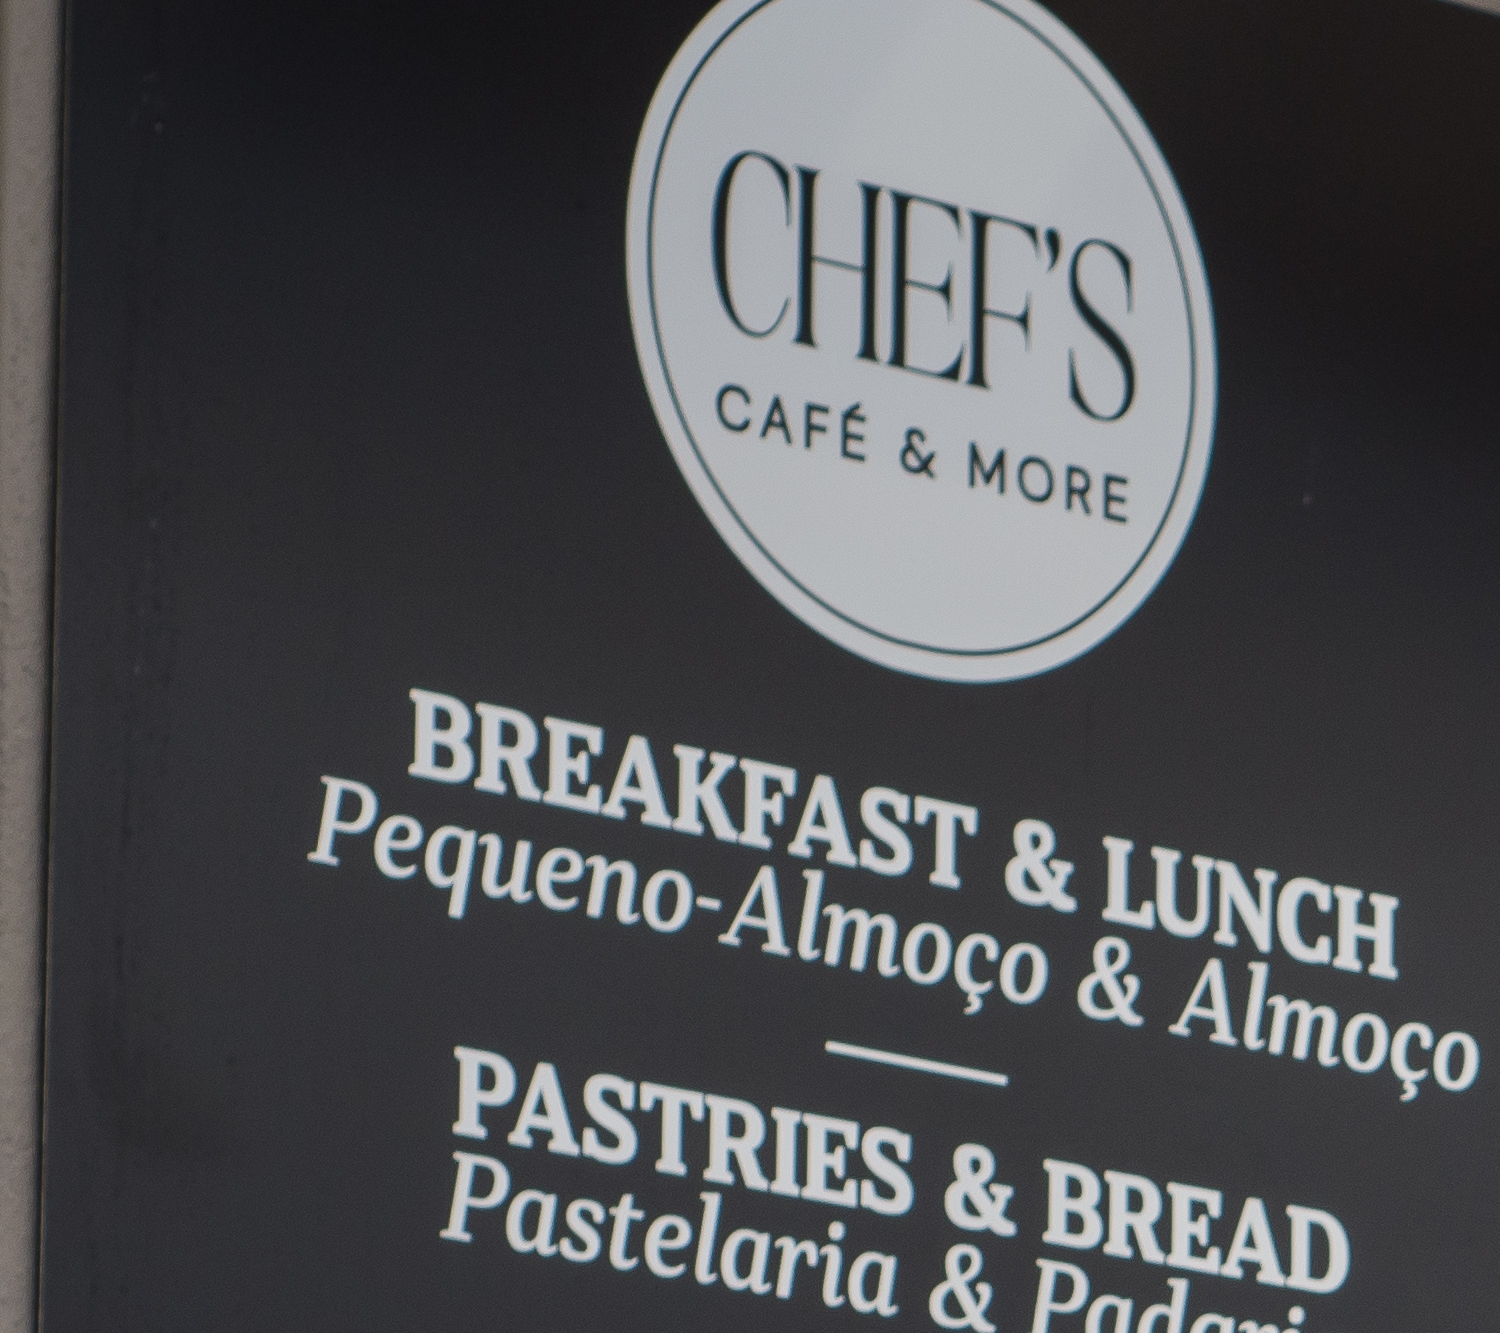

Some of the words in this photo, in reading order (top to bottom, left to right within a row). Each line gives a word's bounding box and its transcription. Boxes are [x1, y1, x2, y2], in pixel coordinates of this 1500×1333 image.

[711, 149, 1136, 422] CHEF'S
[716, 384, 866, 462] CAFÉ
[901, 428, 936, 478] &
[969, 443, 1129, 523] MORE
[305, 773, 1050, 1017] Pequeno-Almoço
[1075, 934, 1146, 1028] &
[1166, 956, 1481, 1104] Almoço
[406, 686, 980, 891] BREAKFAST
[1003, 817, 1079, 914] &
[1100, 834, 1401, 982] LUNCH
[438, 1149, 900, 1319] Pastelaria
[450, 1044, 916, 1217] PASTRIES
[943, 1141, 1019, 1239] &
[1040, 1156, 1352, 1296] BREAD
